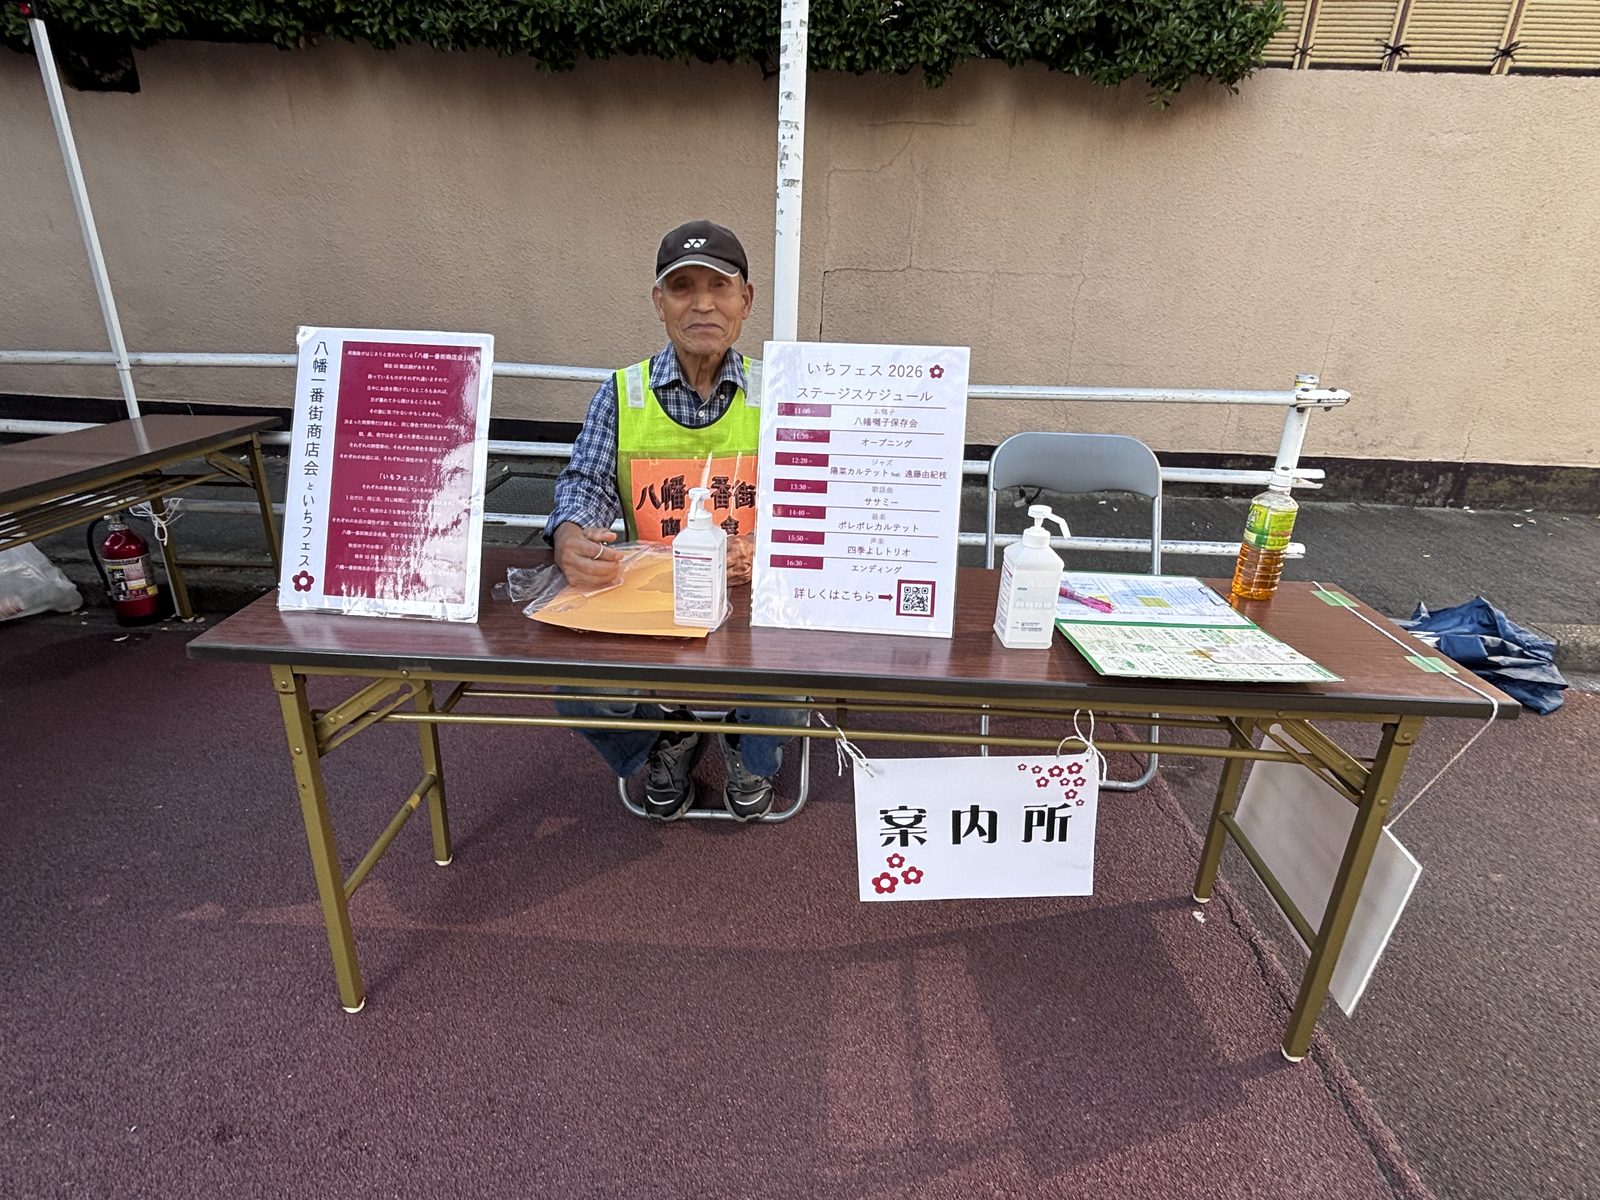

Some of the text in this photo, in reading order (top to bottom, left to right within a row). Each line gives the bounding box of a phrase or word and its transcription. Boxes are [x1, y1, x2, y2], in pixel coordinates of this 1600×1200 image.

[807, 361, 924, 379] いちフェス 2026
[796, 387, 934, 402] ステージスケジュール
[853, 417, 919, 429] 八幡囃子保存会
[861, 438, 913, 448] オープニング
[299, 341, 329, 567] 八幡一番街商店会といちフェス
[871, 459, 893, 467] ジャズ
[829, 466, 889, 477] 陽菜カルテット
[904, 469, 948, 480] 遠藤由紀枝
[636, 474, 756, 511] 八幡番街
[871, 485, 894, 494] 歌謡曲
[864, 497, 899, 507] ササミー
[661, 515, 740, 538] 商会
[837, 521, 919, 533] ポレポレカルテット
[847, 545, 911, 557] 四季よしトリオ
[851, 564, 902, 574] エンディング
[794, 587, 874, 602] 詳しくはこちら
[880, 802, 1072, 847] 案内所
